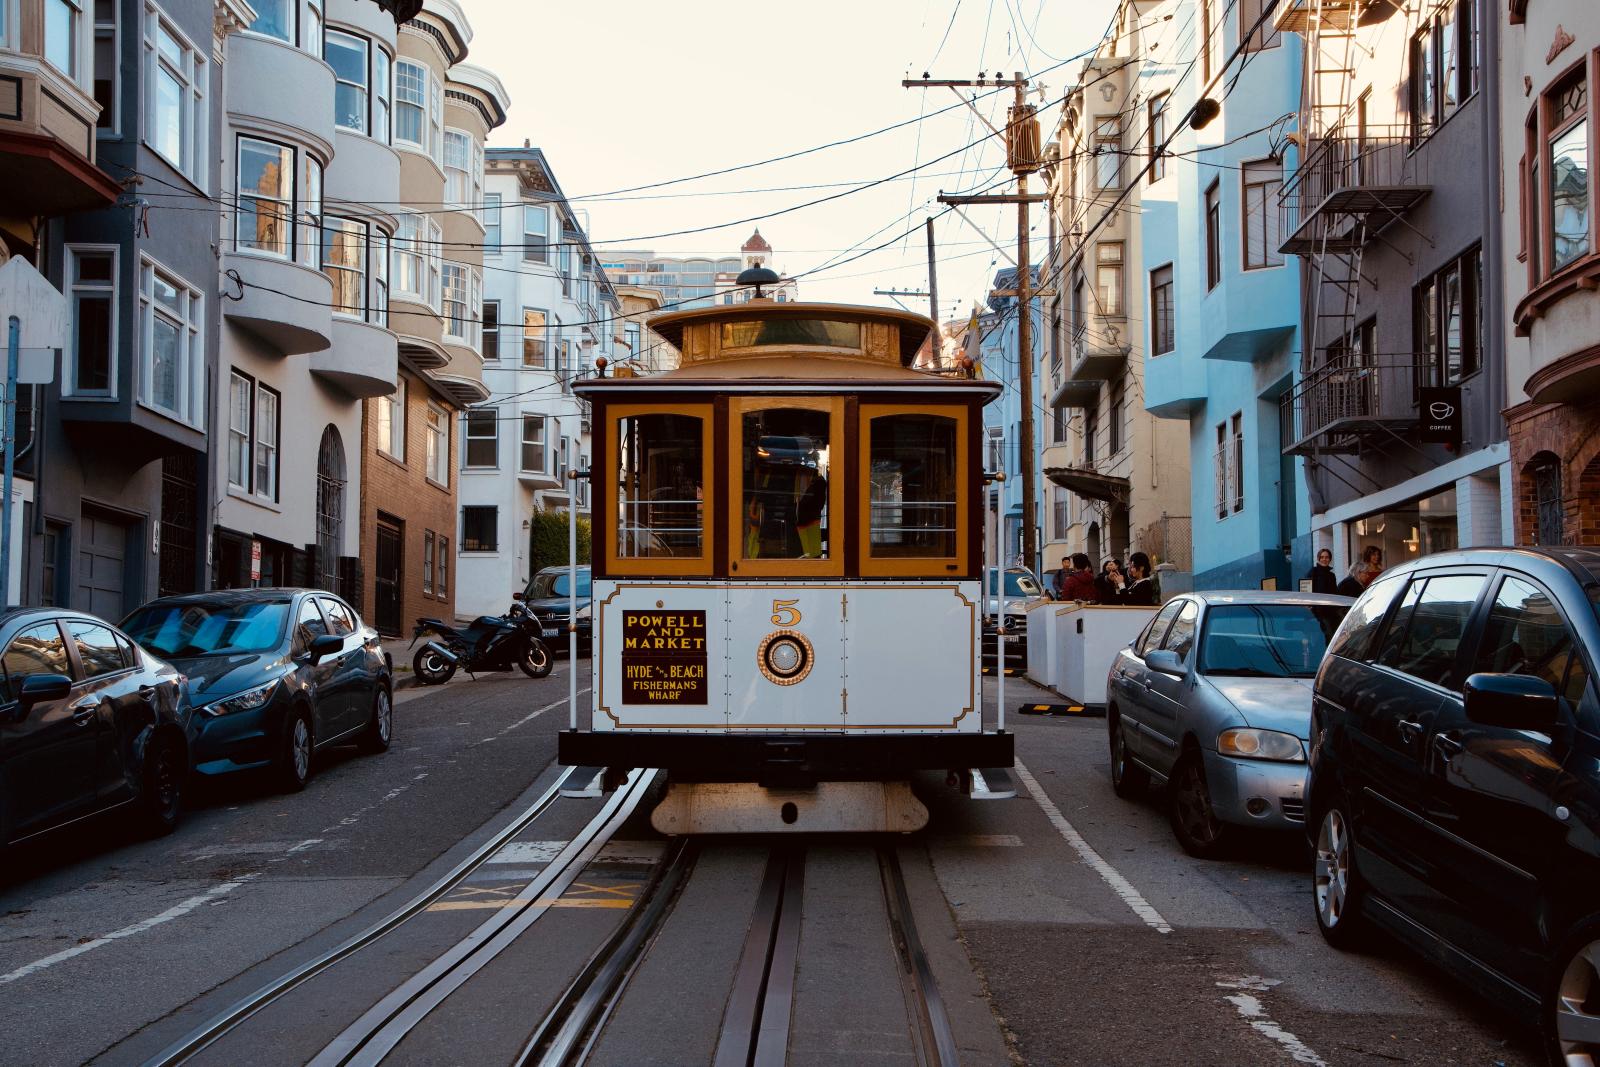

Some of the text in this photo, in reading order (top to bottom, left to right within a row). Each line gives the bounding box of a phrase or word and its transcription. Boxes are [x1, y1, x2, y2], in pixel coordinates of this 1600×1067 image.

[771, 599, 802, 627] 5
[627, 616, 704, 627] POWELL
[647, 628, 685, 637] AND
[625, 638, 704, 649] MARKET
[627, 665, 653, 678] HYDE
[670, 665, 704, 678] BEACH
[633, 681, 697, 690] FISHERMANS
[648, 691, 681, 700] WHARF
